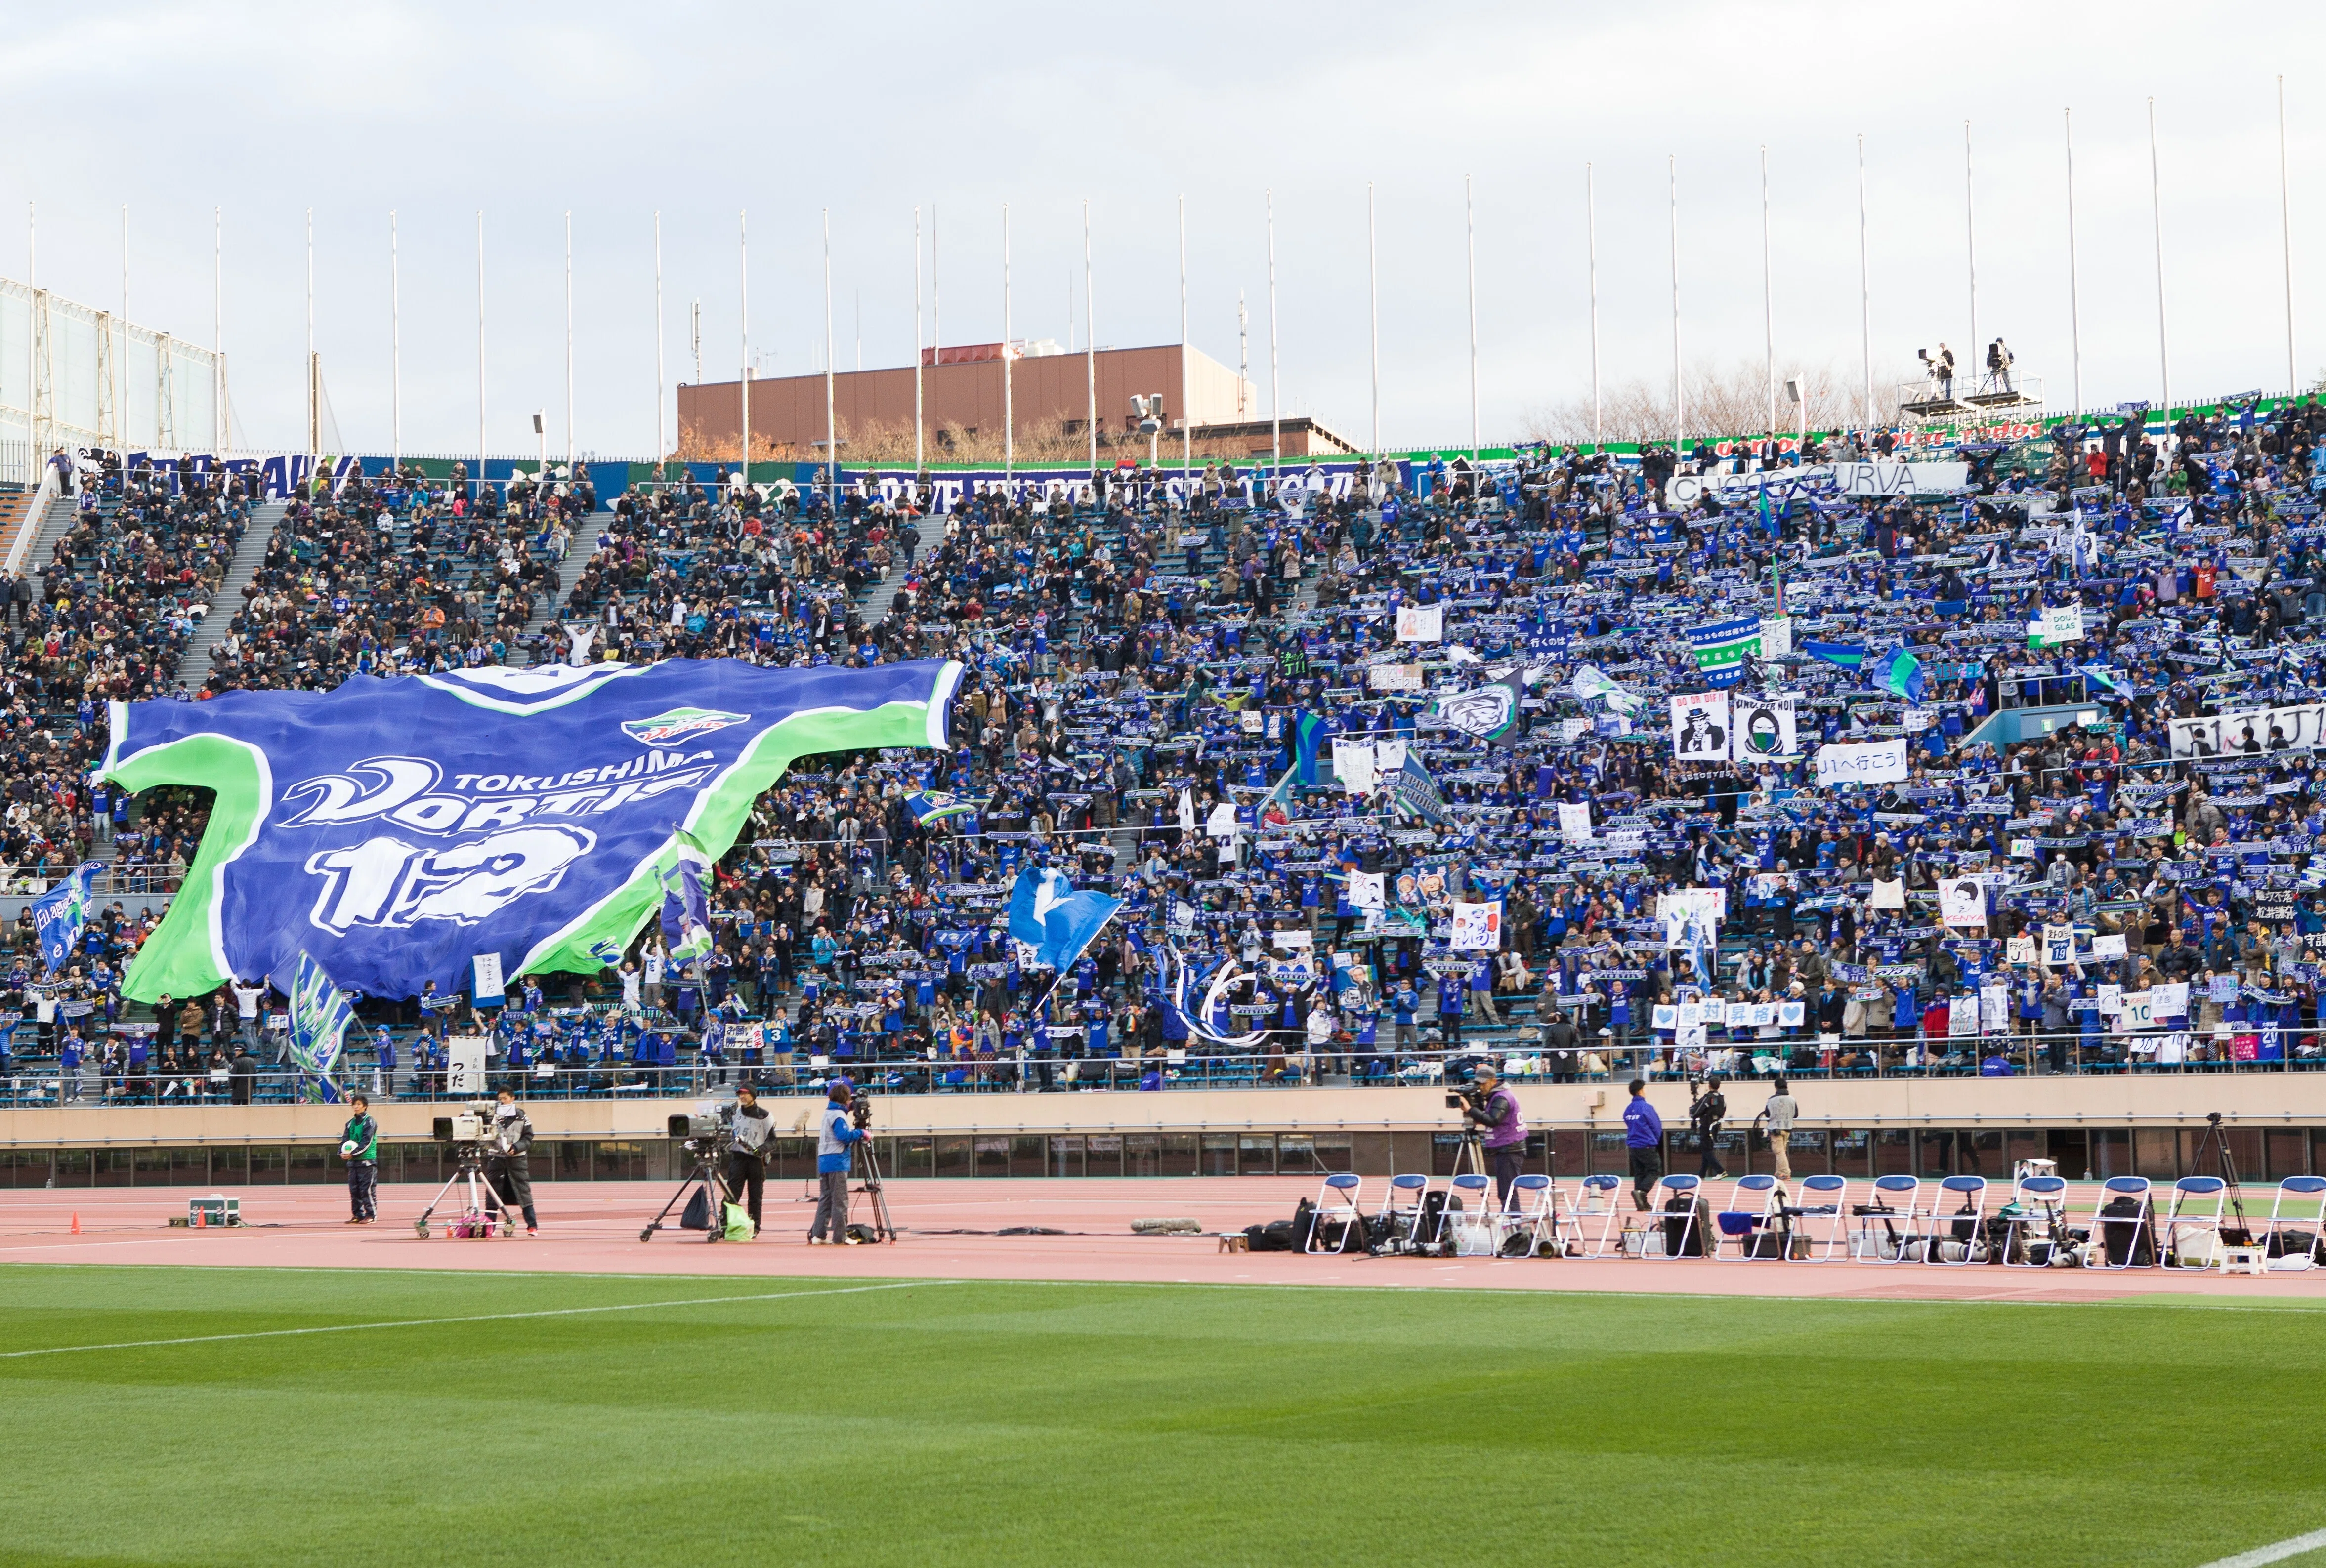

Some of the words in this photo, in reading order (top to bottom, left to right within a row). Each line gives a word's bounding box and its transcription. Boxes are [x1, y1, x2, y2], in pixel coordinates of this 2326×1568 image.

[1530, 636, 1566, 648] 行くのは
[1677, 698, 1687, 707] DO
[1691, 696, 1701, 704] OR
[1705, 694, 1716, 703] DIE
[1778, 699, 1792, 711] NOI
[2082, 717, 2092, 726] 11
[1819, 751, 1903, 774] J1へ行こう!
[454, 749, 714, 793] TOKUSHIMA
[304, 824, 597, 938] 12
[1354, 874, 1367, 890] 攻
[1943, 886, 1949, 899] 1
[2055, 949, 2066, 959] 19
[483, 958, 494, 993] はまだ
[2131, 1005, 2150, 1021] 10
[2177, 1005, 2185, 1014] 10
[765, 1020, 785, 1030] GOAL
[771, 1029, 781, 1041] 3
[452, 1062, 464, 1087] つだ
